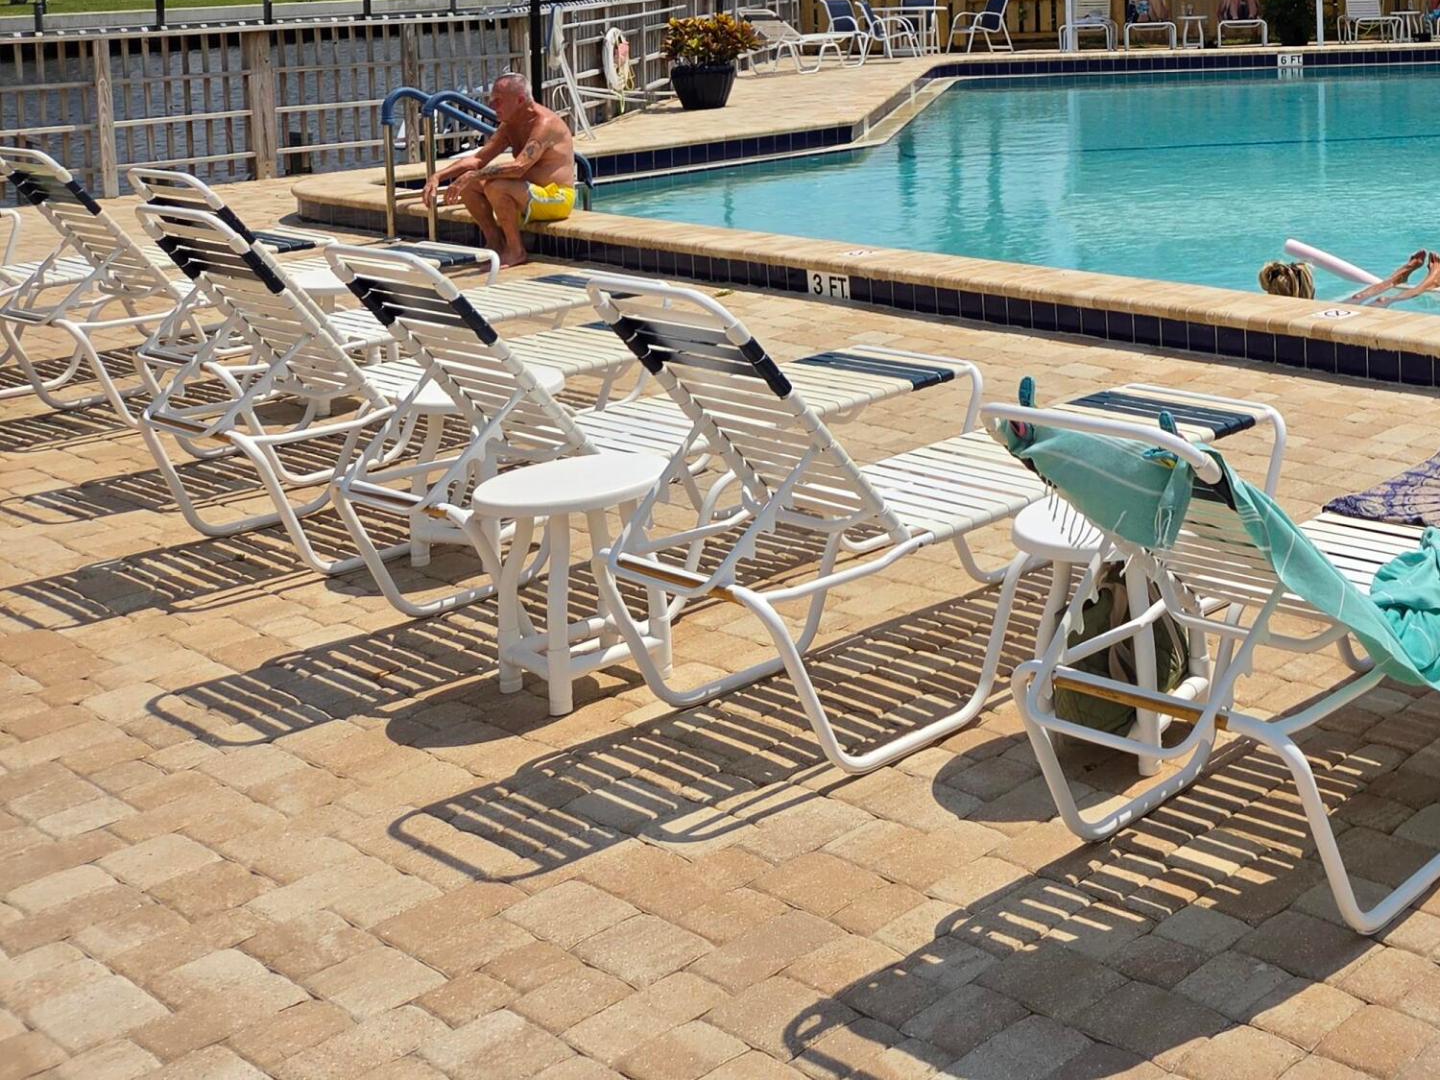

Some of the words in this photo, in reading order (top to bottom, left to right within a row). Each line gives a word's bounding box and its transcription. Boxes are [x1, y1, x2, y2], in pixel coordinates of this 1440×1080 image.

[1280, 55, 1287, 65] 6
[813, 273, 823, 295] 3
[829, 275, 849, 299] FT.
